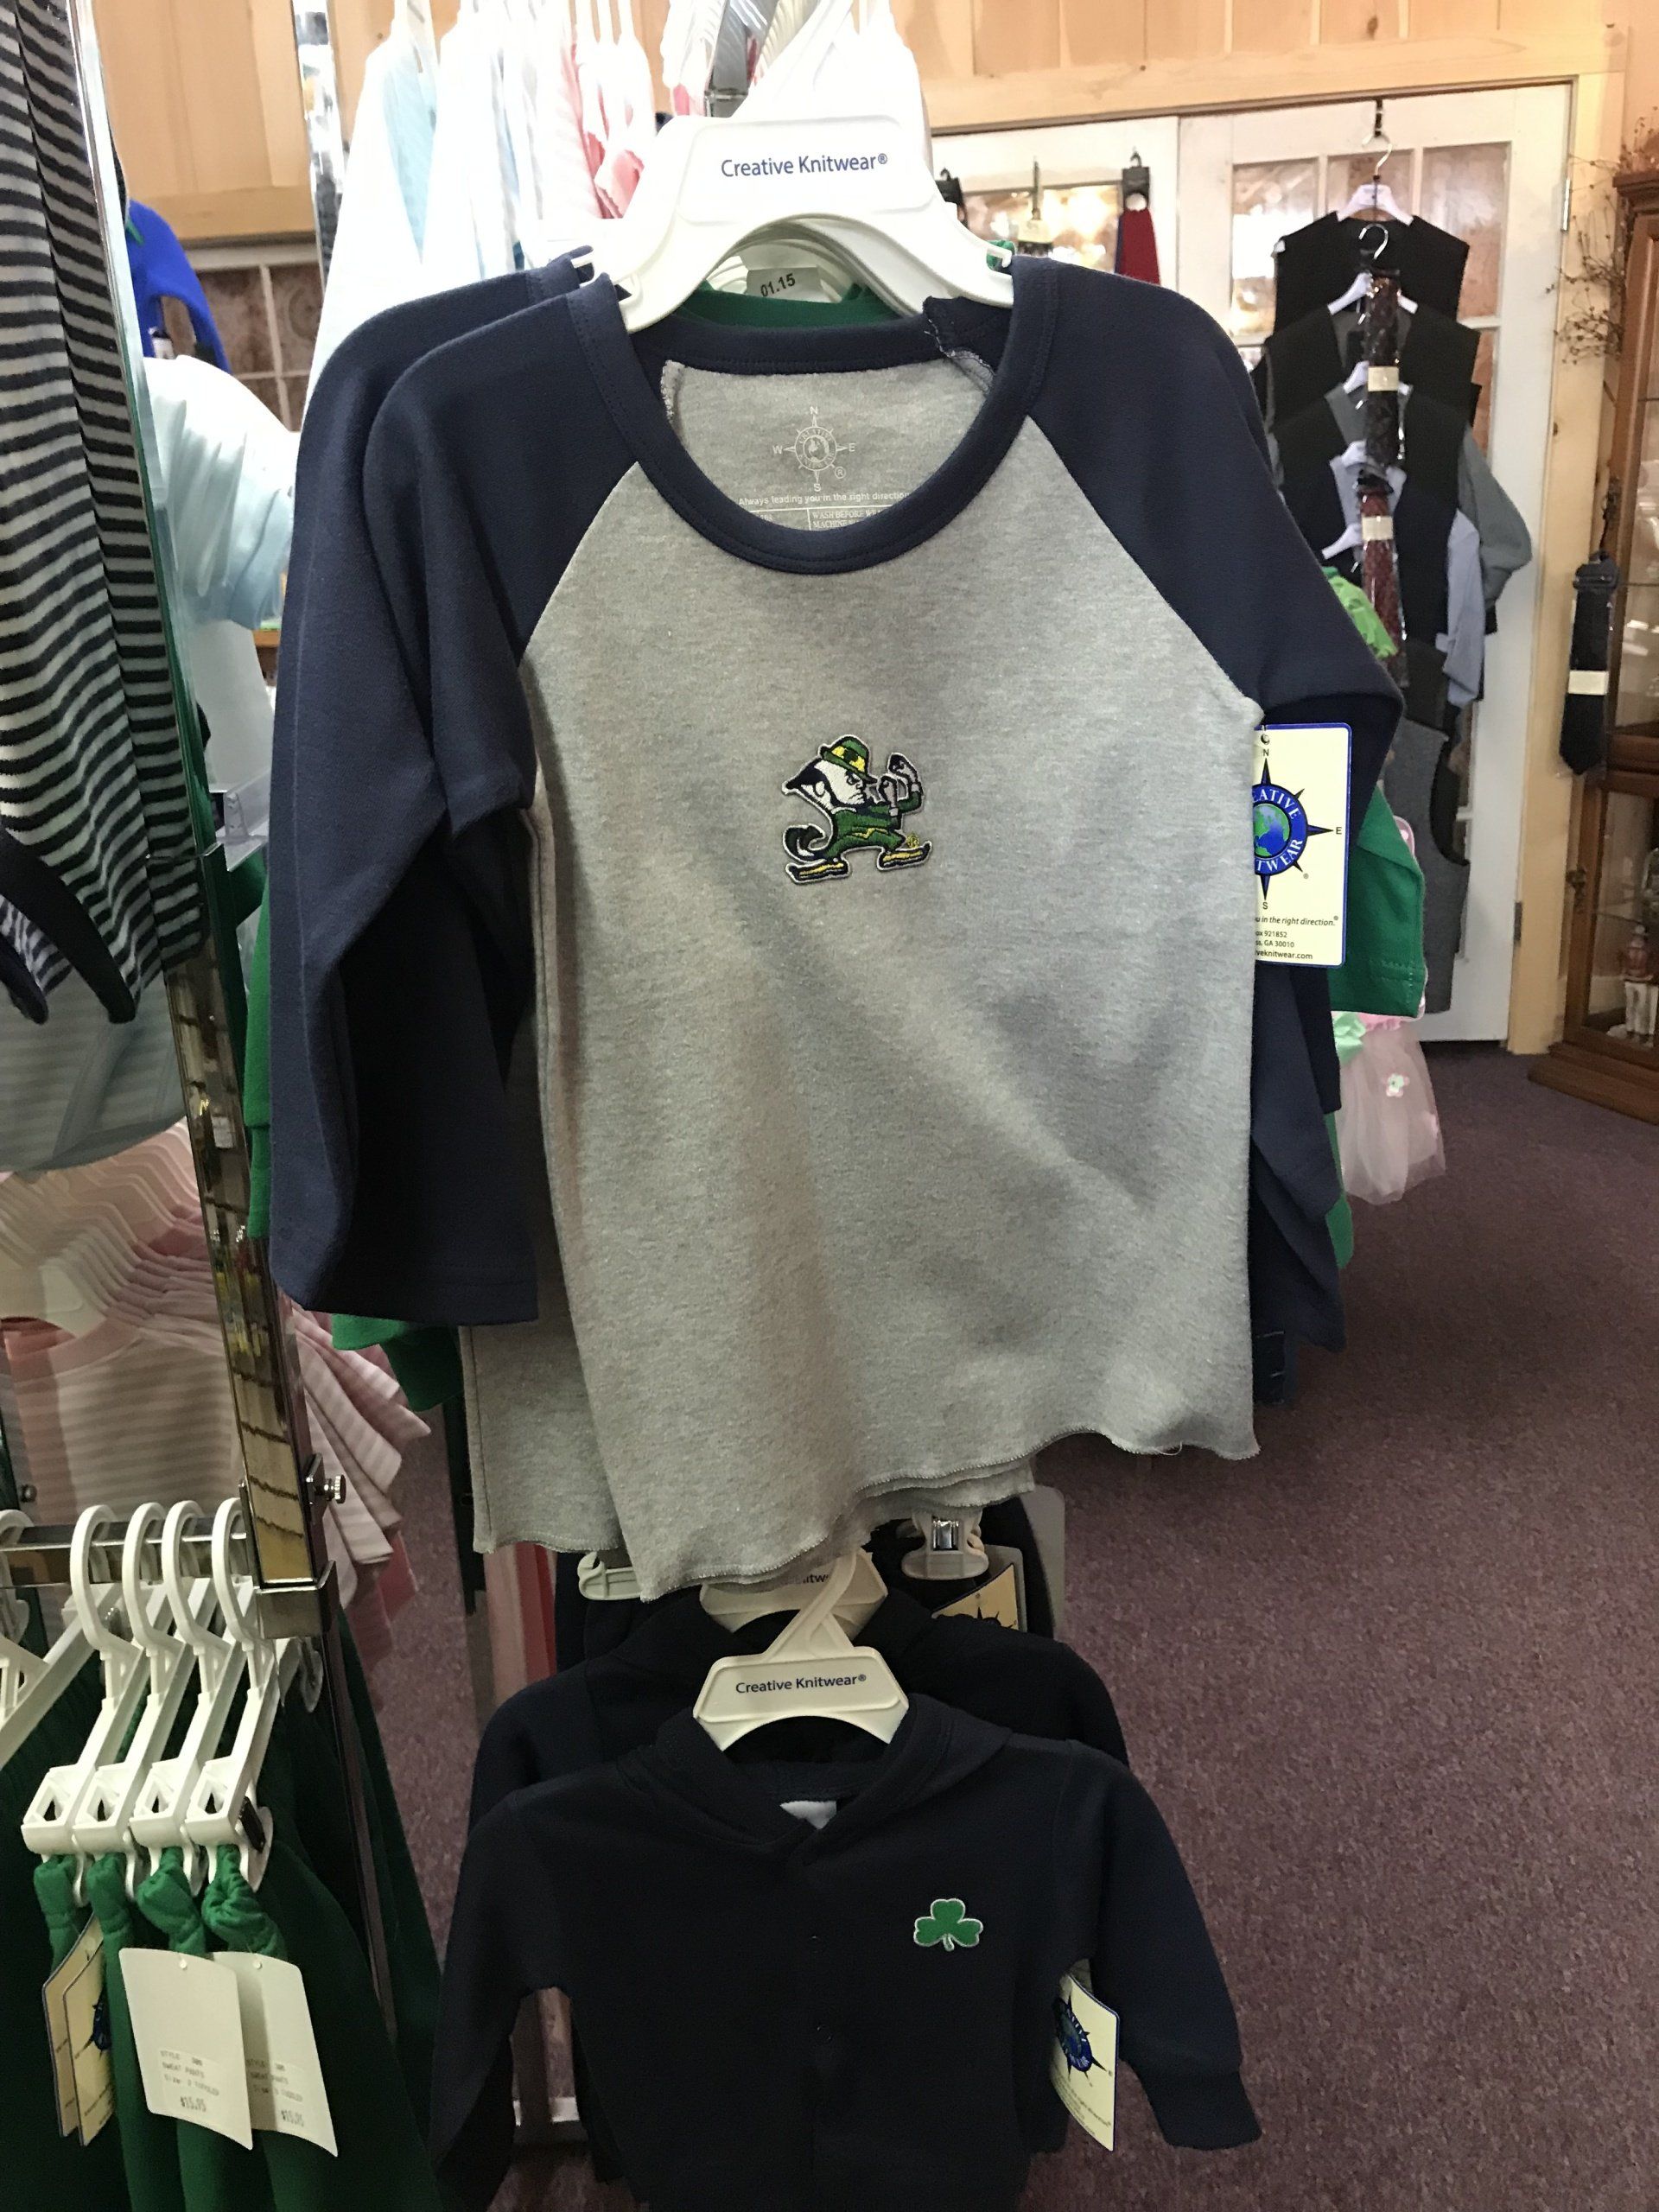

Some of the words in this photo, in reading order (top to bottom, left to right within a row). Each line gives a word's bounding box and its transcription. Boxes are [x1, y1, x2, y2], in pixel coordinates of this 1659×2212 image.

[721, 157, 794, 177] Creative
[760, 272, 796, 297] 01.15
[810, 406, 818, 415] N
[772, 445, 783, 454] W
[849, 442, 856, 452] E
[813, 483, 822, 493] S
[738, 497, 769, 506] Always
[771, 495, 803, 505] leading
[832, 493, 847, 501] the
[849, 492, 870, 503] right
[1262, 748, 1269, 757] N
[1335, 826, 1343, 835] E
[1255, 838, 1304, 873] TWEAR
[1262, 901, 1268, 910] S
[1281, 918, 1299, 926] right
[1264, 930, 1287, 938] 921852
[735, 1680, 792, 1694] Creative
